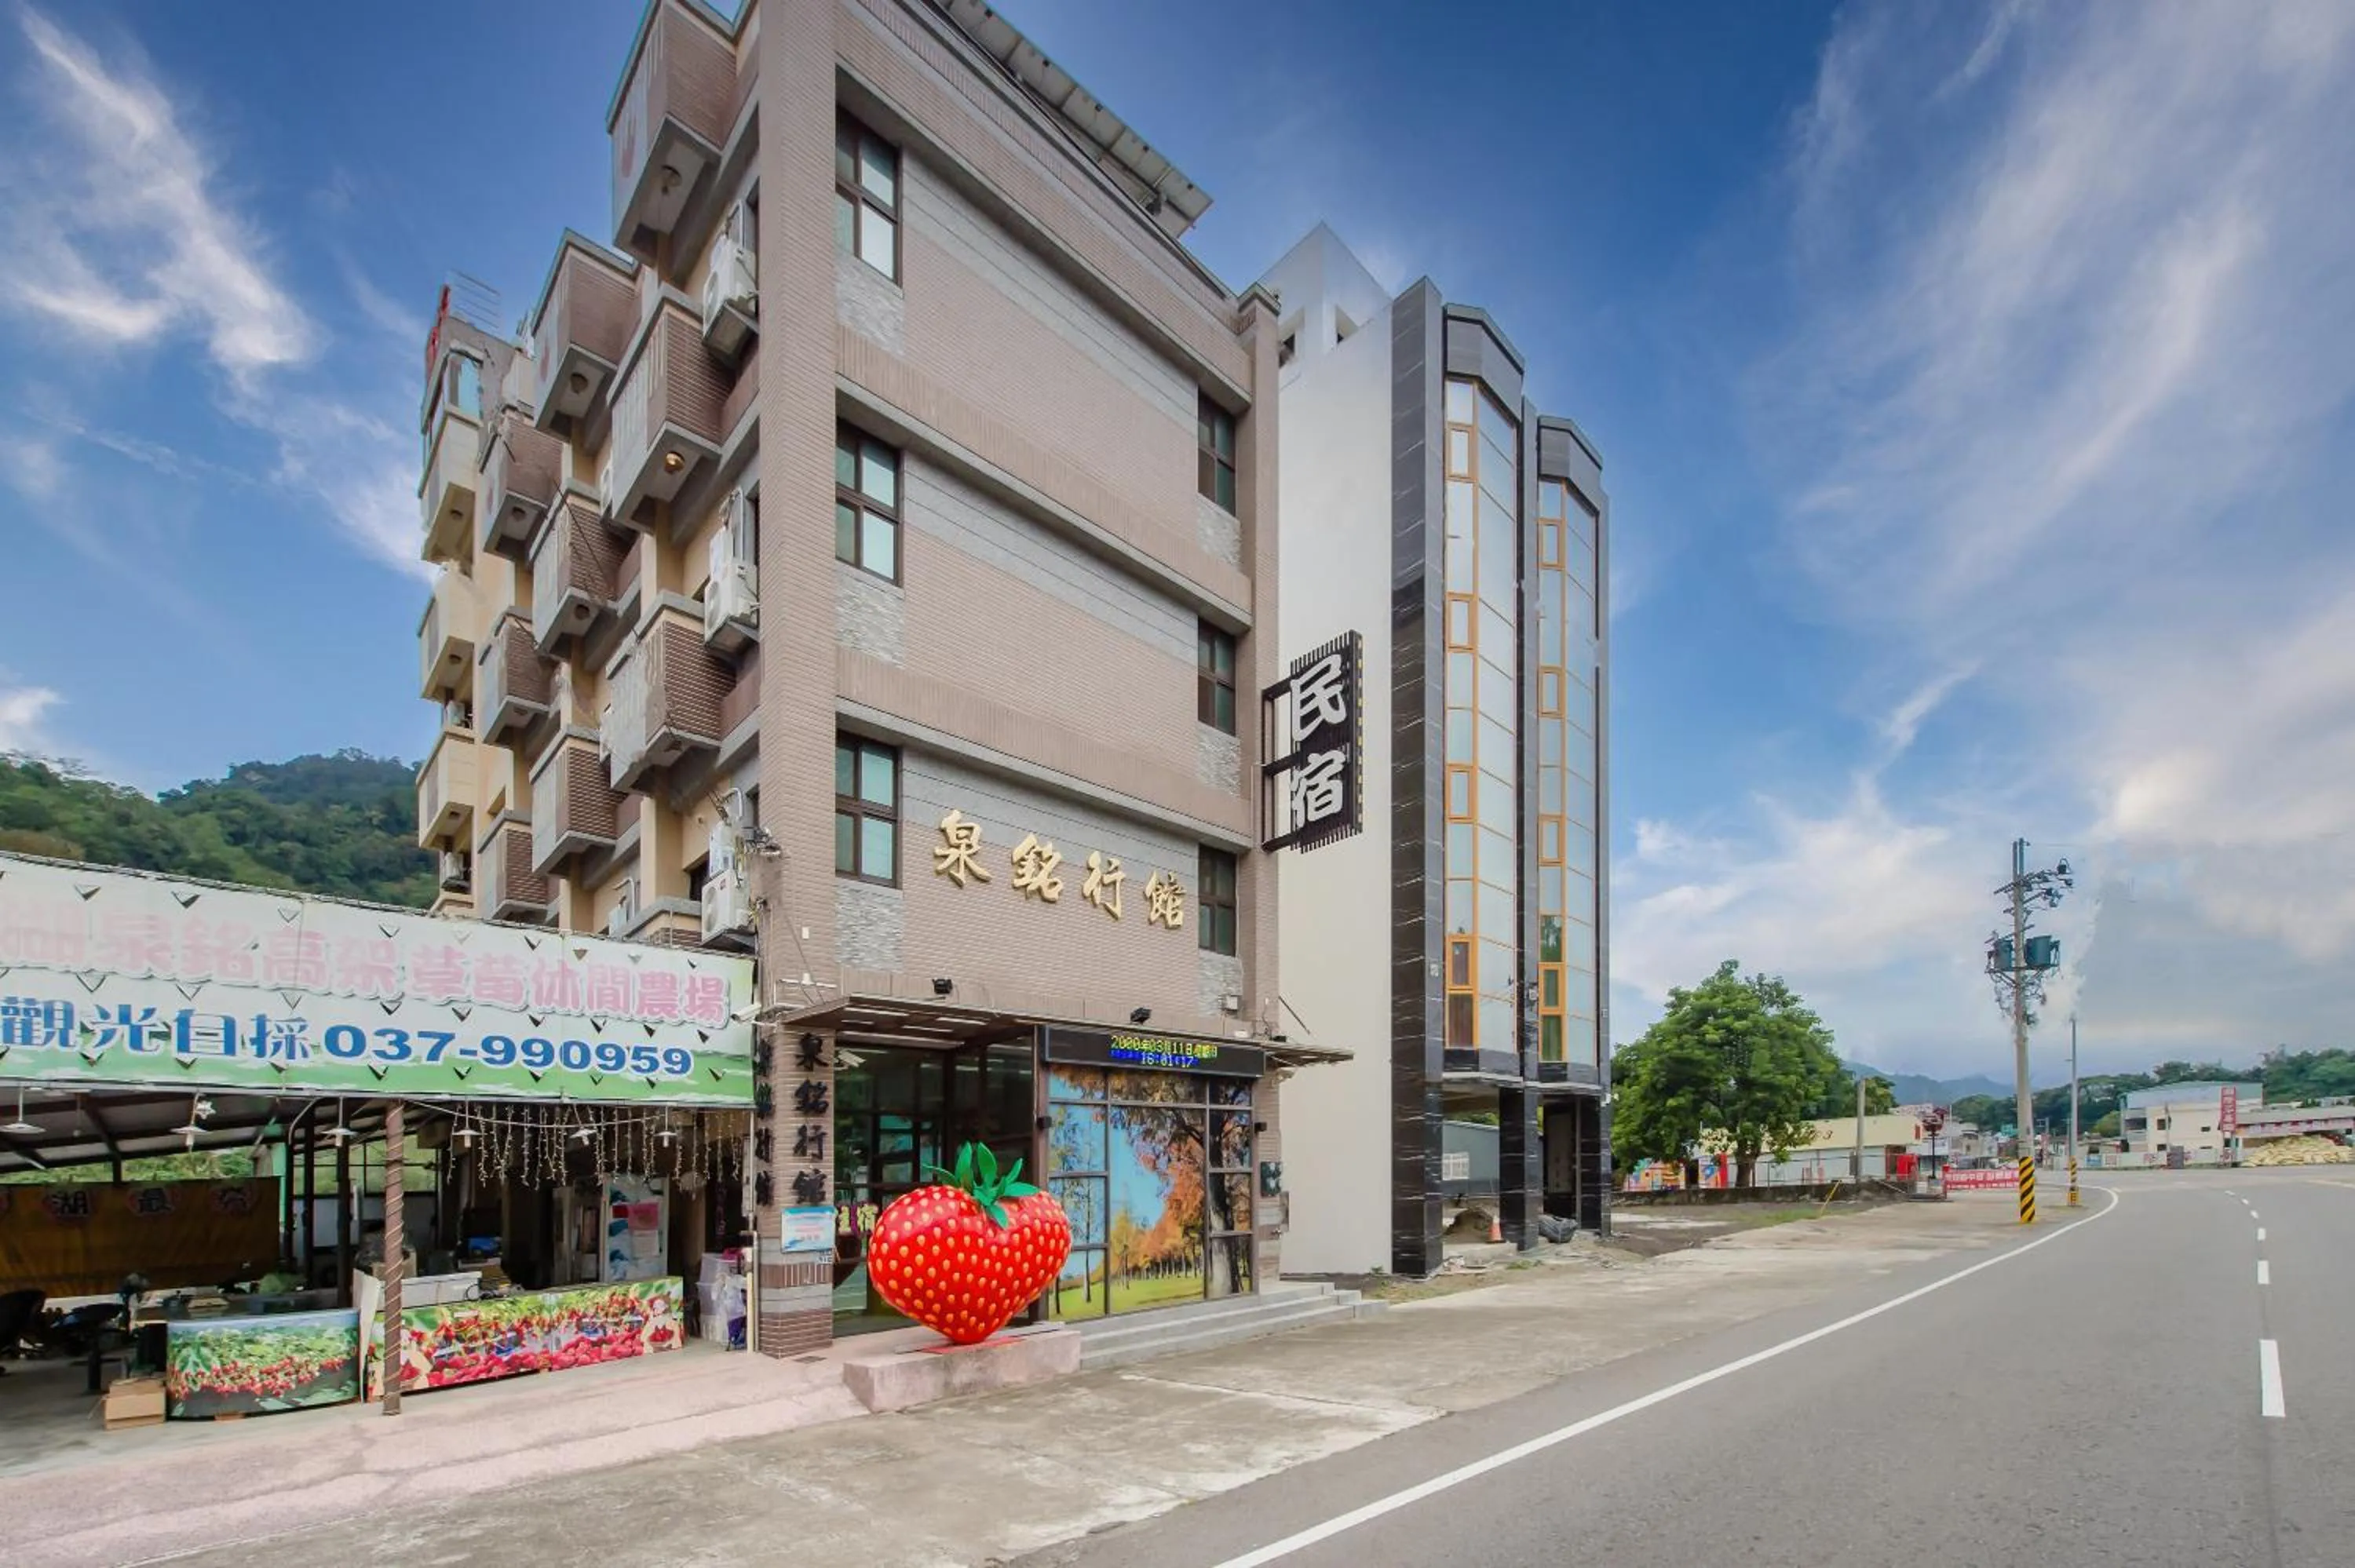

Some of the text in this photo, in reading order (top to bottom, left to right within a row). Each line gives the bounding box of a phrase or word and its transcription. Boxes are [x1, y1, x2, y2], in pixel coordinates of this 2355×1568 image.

[1289, 653, 1347, 828] 民宿
[934, 809, 1187, 929] 泉銘行館
[0, 995, 692, 1075] 觀光自採 037-990959
[792, 1032, 830, 1205] 泉銘行館
